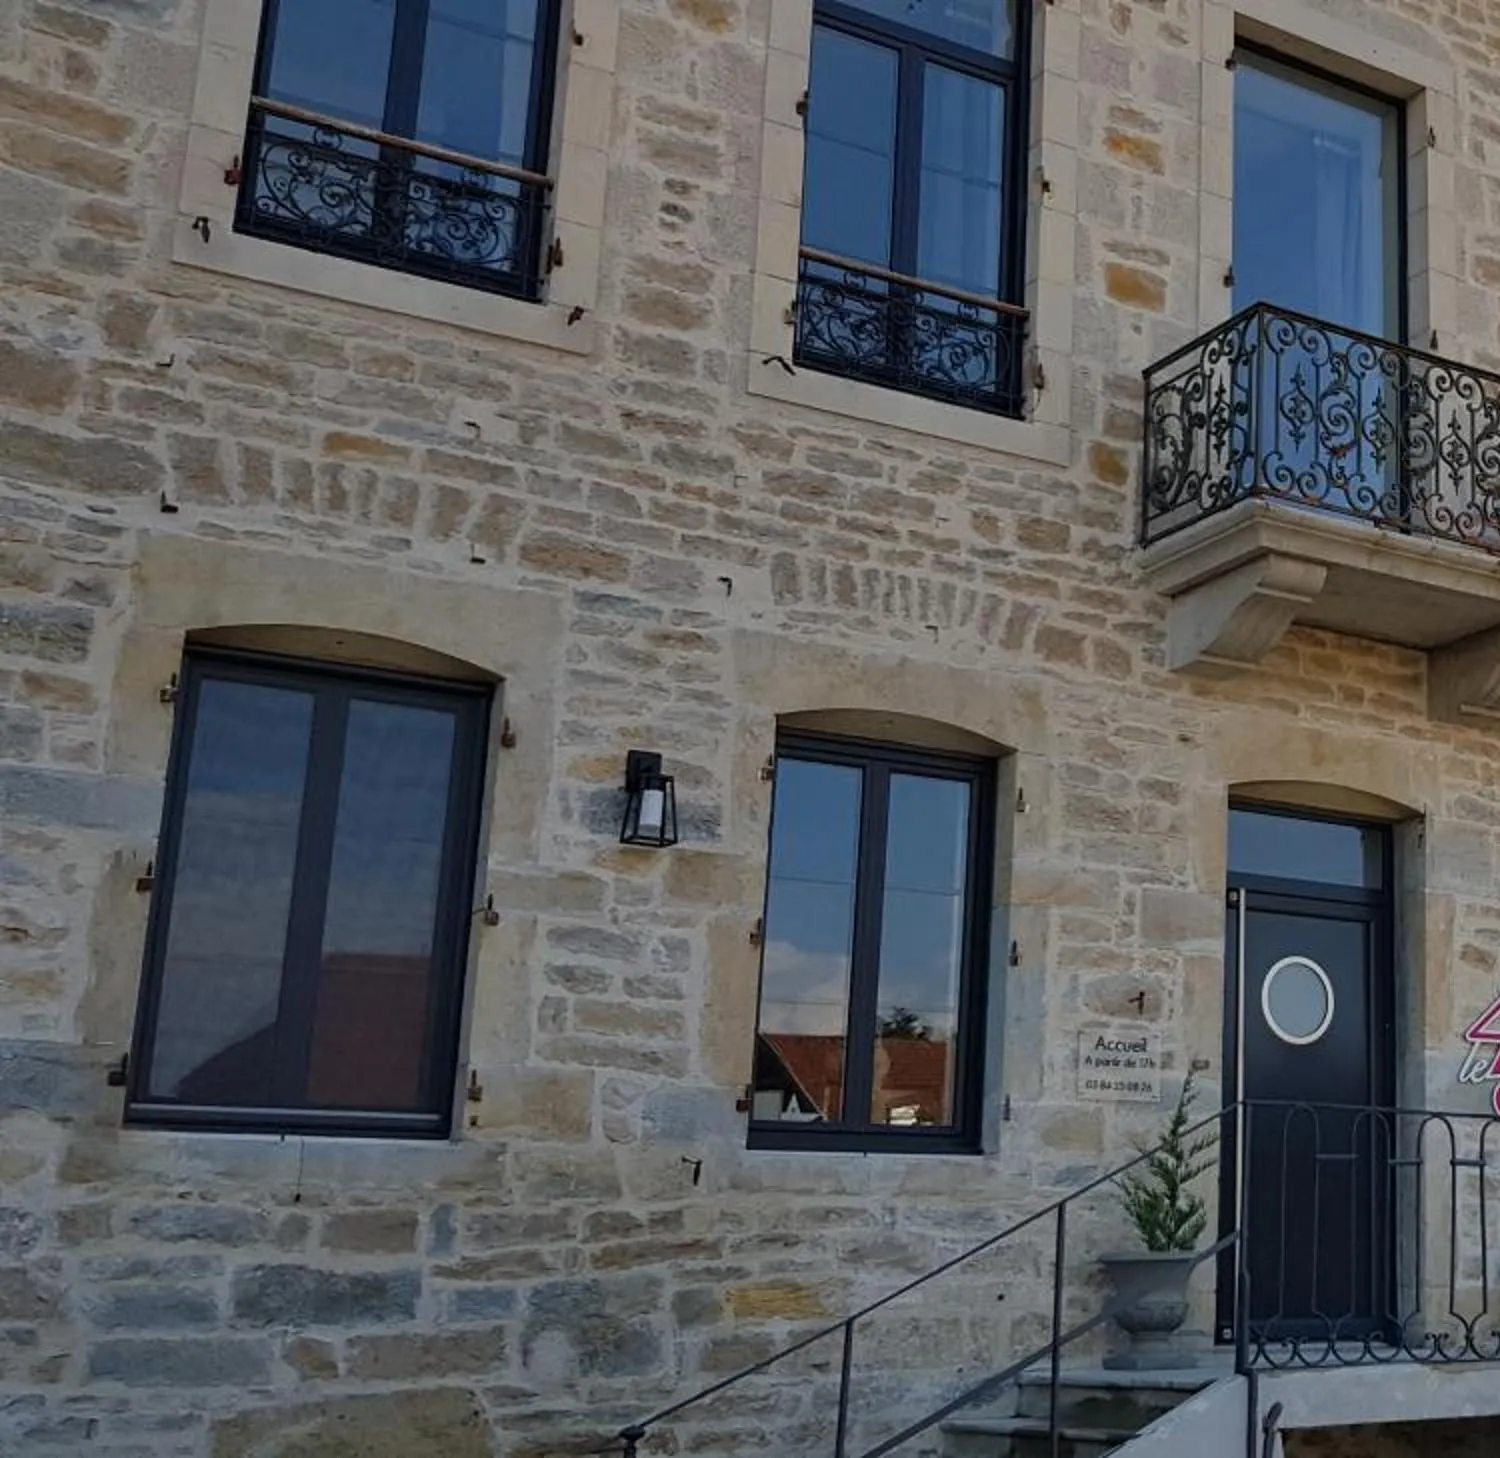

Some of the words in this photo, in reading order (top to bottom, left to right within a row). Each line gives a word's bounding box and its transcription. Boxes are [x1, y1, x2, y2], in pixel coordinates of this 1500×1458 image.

[1095, 1035, 1147, 1053] Accueil
[1095, 1056, 1121, 1068] partir
[1124, 1057, 1137, 1069] de
[1459, 1041, 1492, 1083] le
